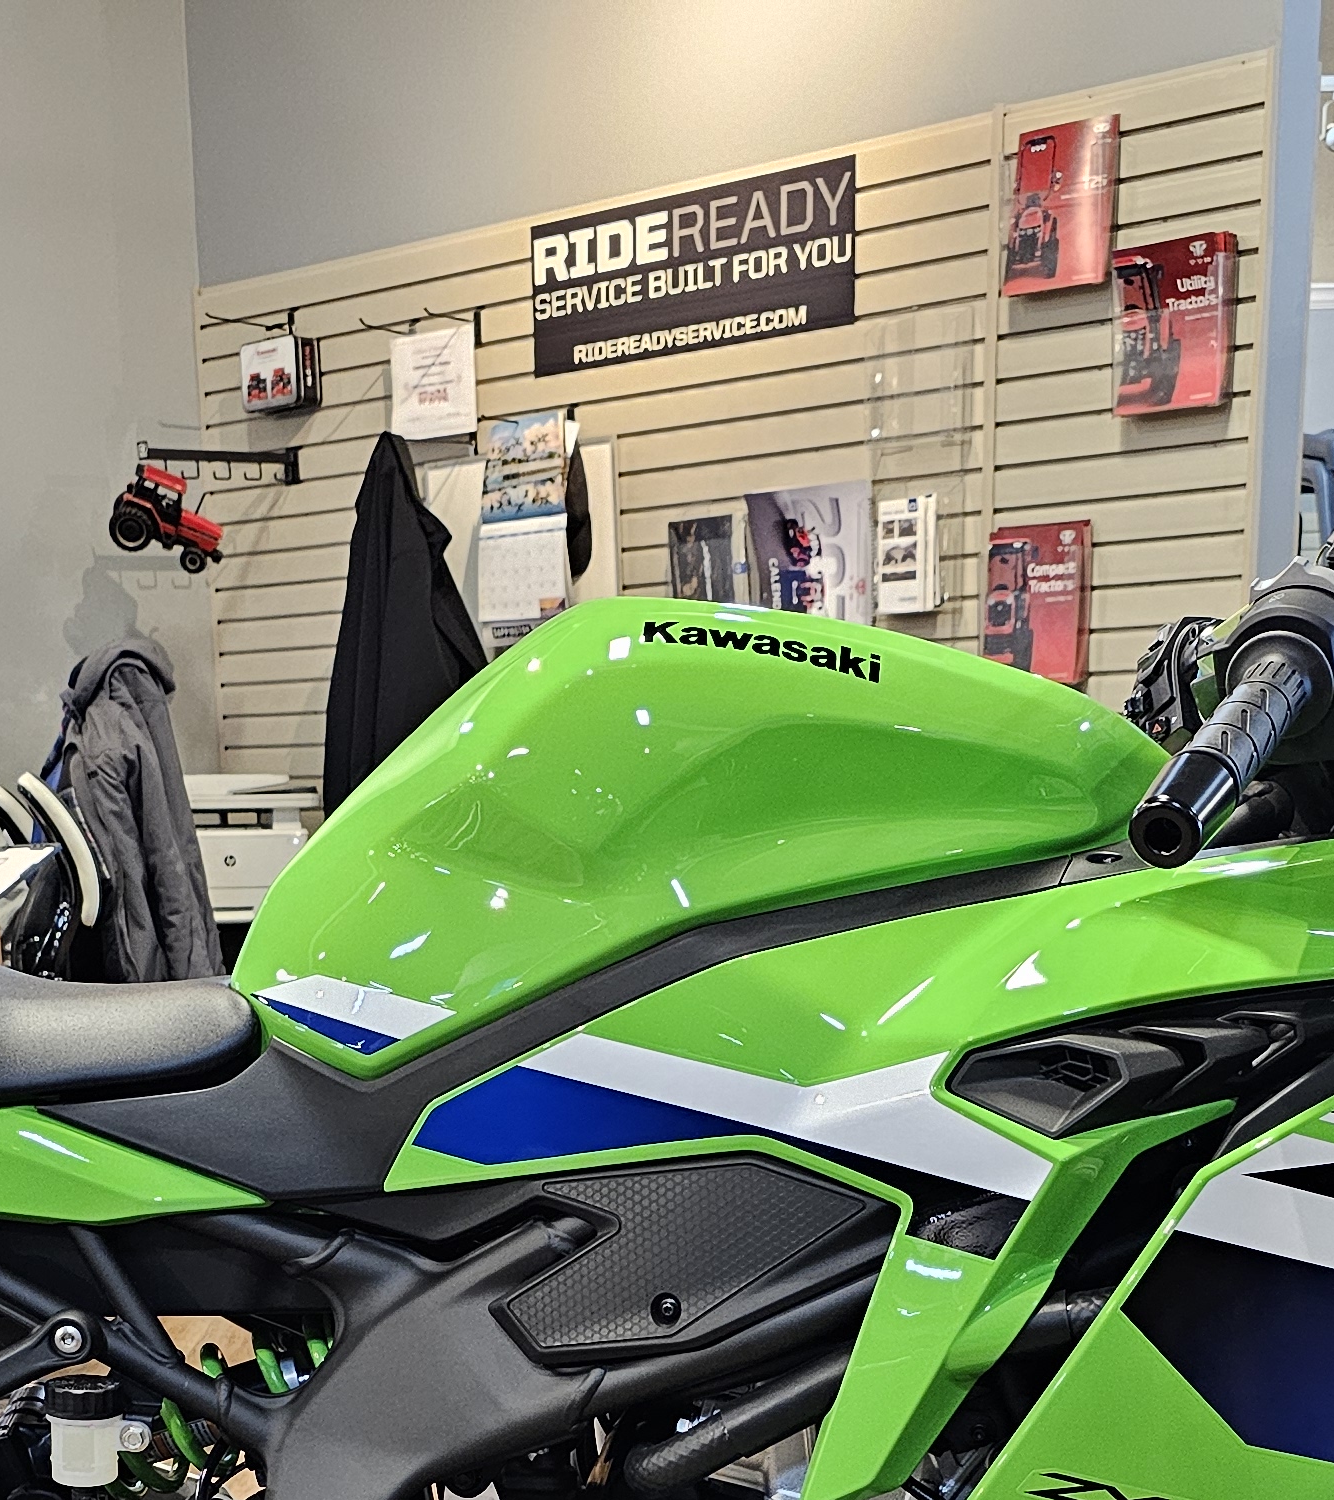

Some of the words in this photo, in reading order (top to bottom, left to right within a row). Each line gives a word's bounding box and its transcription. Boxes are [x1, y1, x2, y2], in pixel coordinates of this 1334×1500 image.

[534, 273, 643, 321] SERVICE
[648, 257, 727, 300] BUILT
[732, 245, 788, 284] FOR
[792, 233, 852, 271] YOU
[1176, 275, 1215, 292] Utility
[1165, 293, 1218, 311] Tractors
[573, 305, 807, 365] RIDEREADYSERVICE.COM
[1027, 561, 1077, 578] Compact
[1028, 579, 1076, 594] Tractors
[643, 621, 881, 684] Kawasaki
